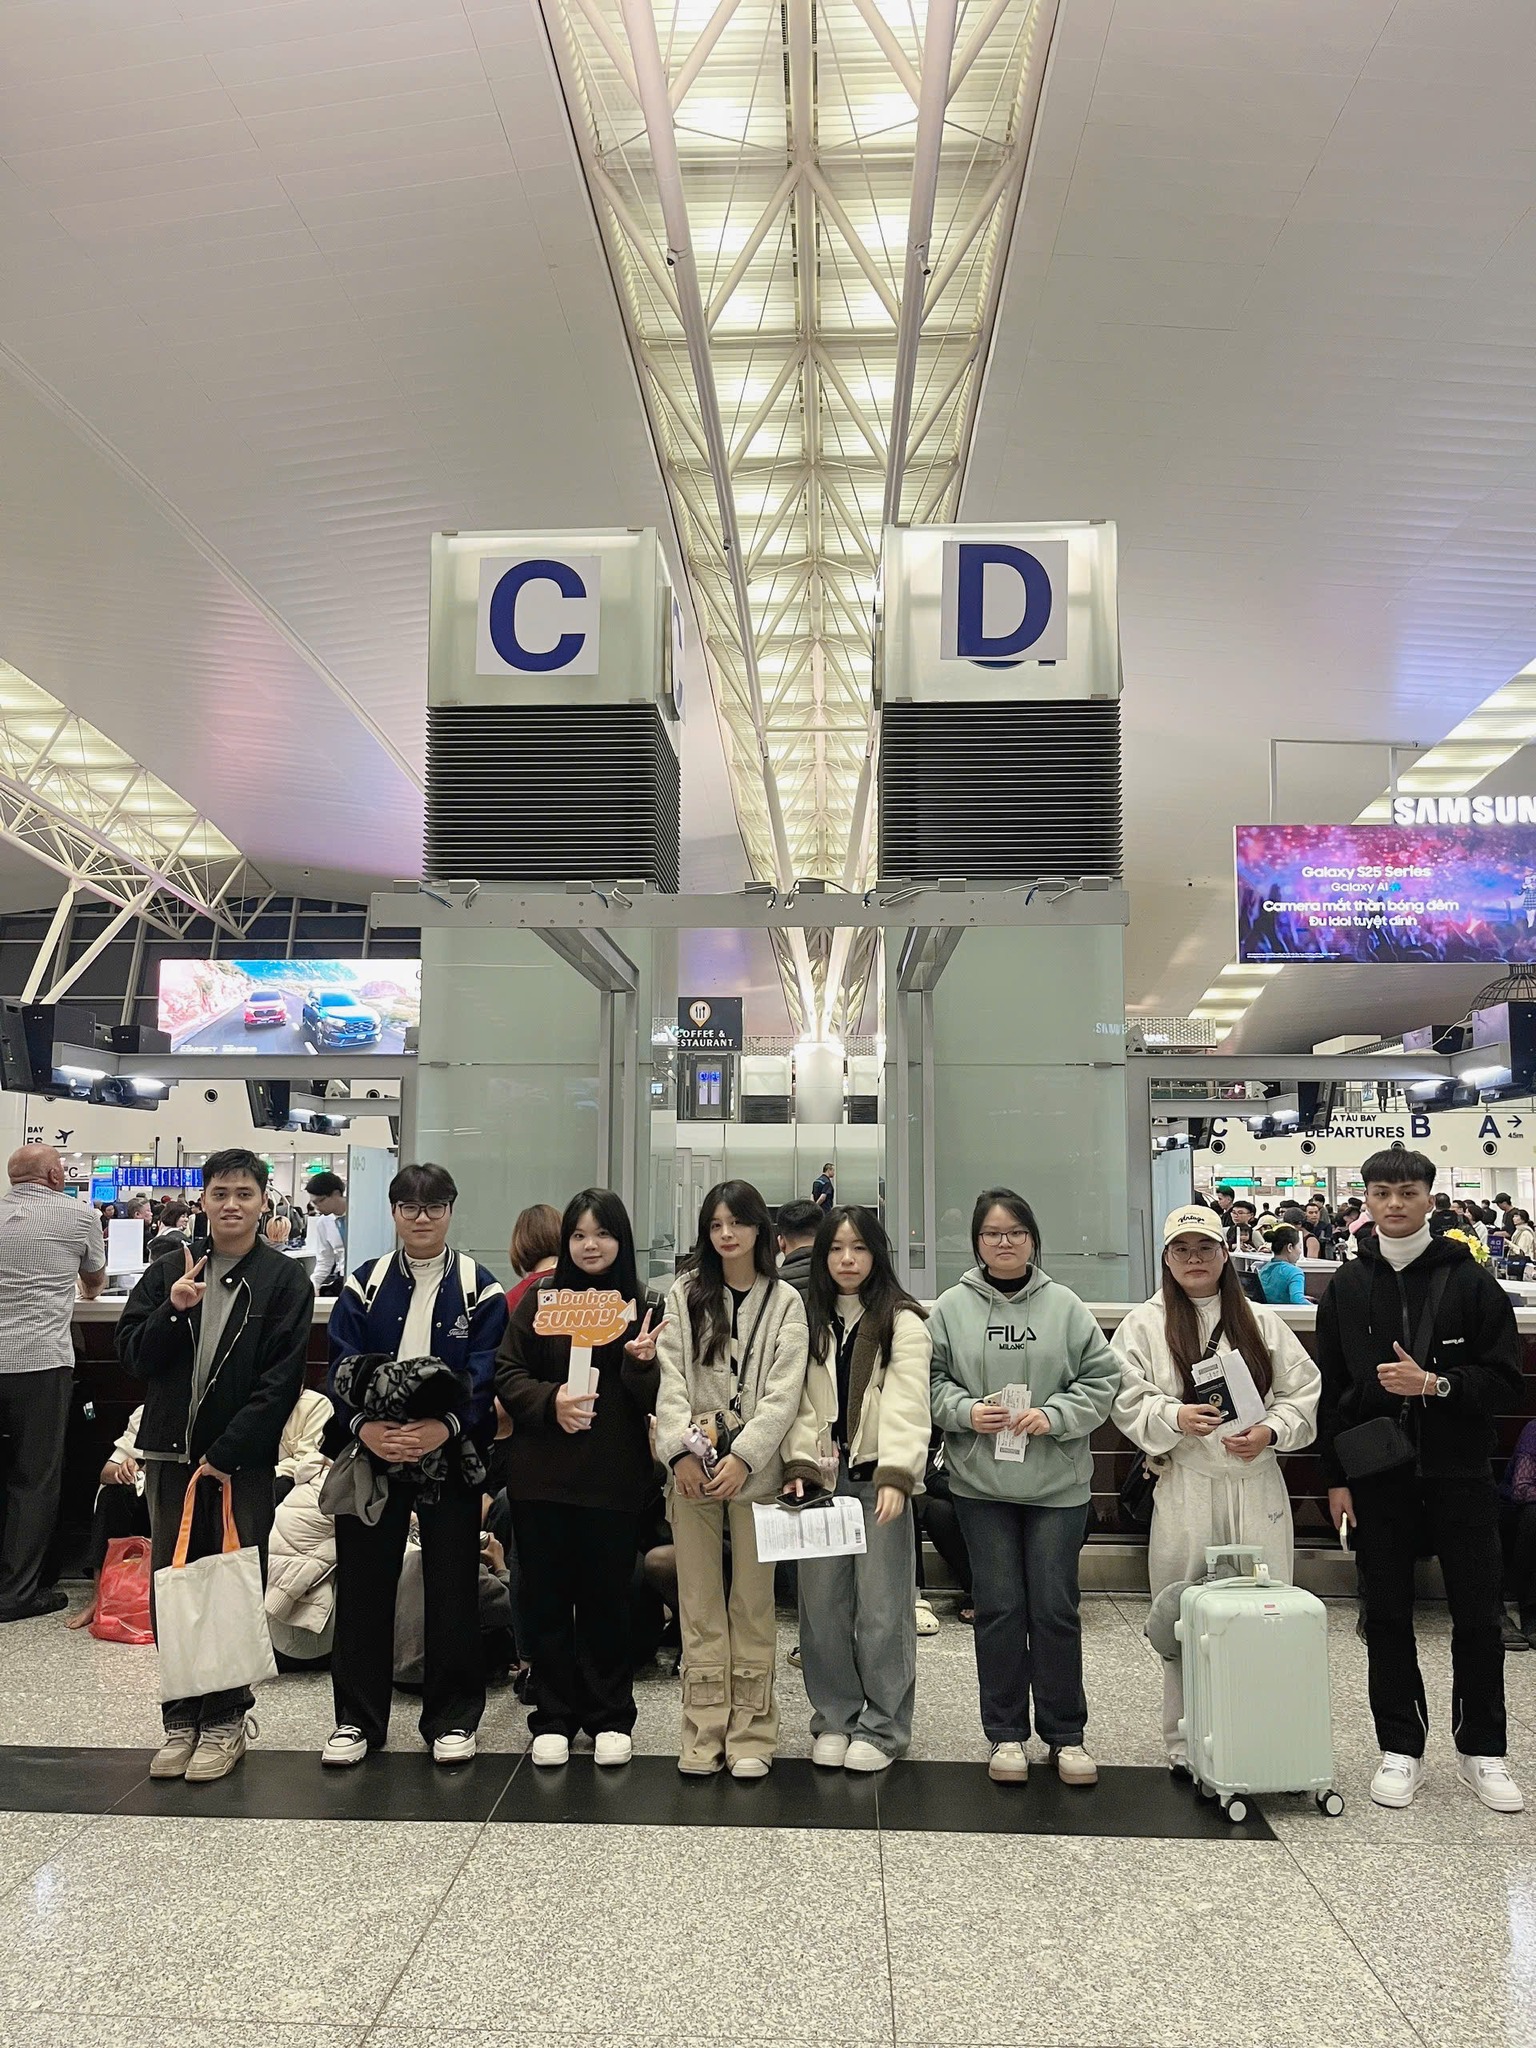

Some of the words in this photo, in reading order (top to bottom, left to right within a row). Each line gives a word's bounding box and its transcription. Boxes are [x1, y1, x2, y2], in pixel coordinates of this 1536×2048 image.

[957, 544, 1052, 656] D
[489, 559, 587, 672] C
[1302, 866, 1355, 880] Galaxy
[1357, 866, 1383, 878] S25
[1385, 866, 1432, 878] Series
[1331, 882, 1375, 894] Galaxy
[1377, 882, 1388, 892] AI
[1263, 900, 1321, 912] Camera
[1387, 899, 1424, 914] bóng
[719, 1030, 725, 1038] &
[1411, 1115, 1431, 1138] B
[1478, 1115, 1501, 1138] A
[560, 1291, 585, 1306] Du
[586, 1290, 619, 1308] học
[535, 1308, 618, 1328] SUNNY
[987, 1325, 1037, 1342] FILA
